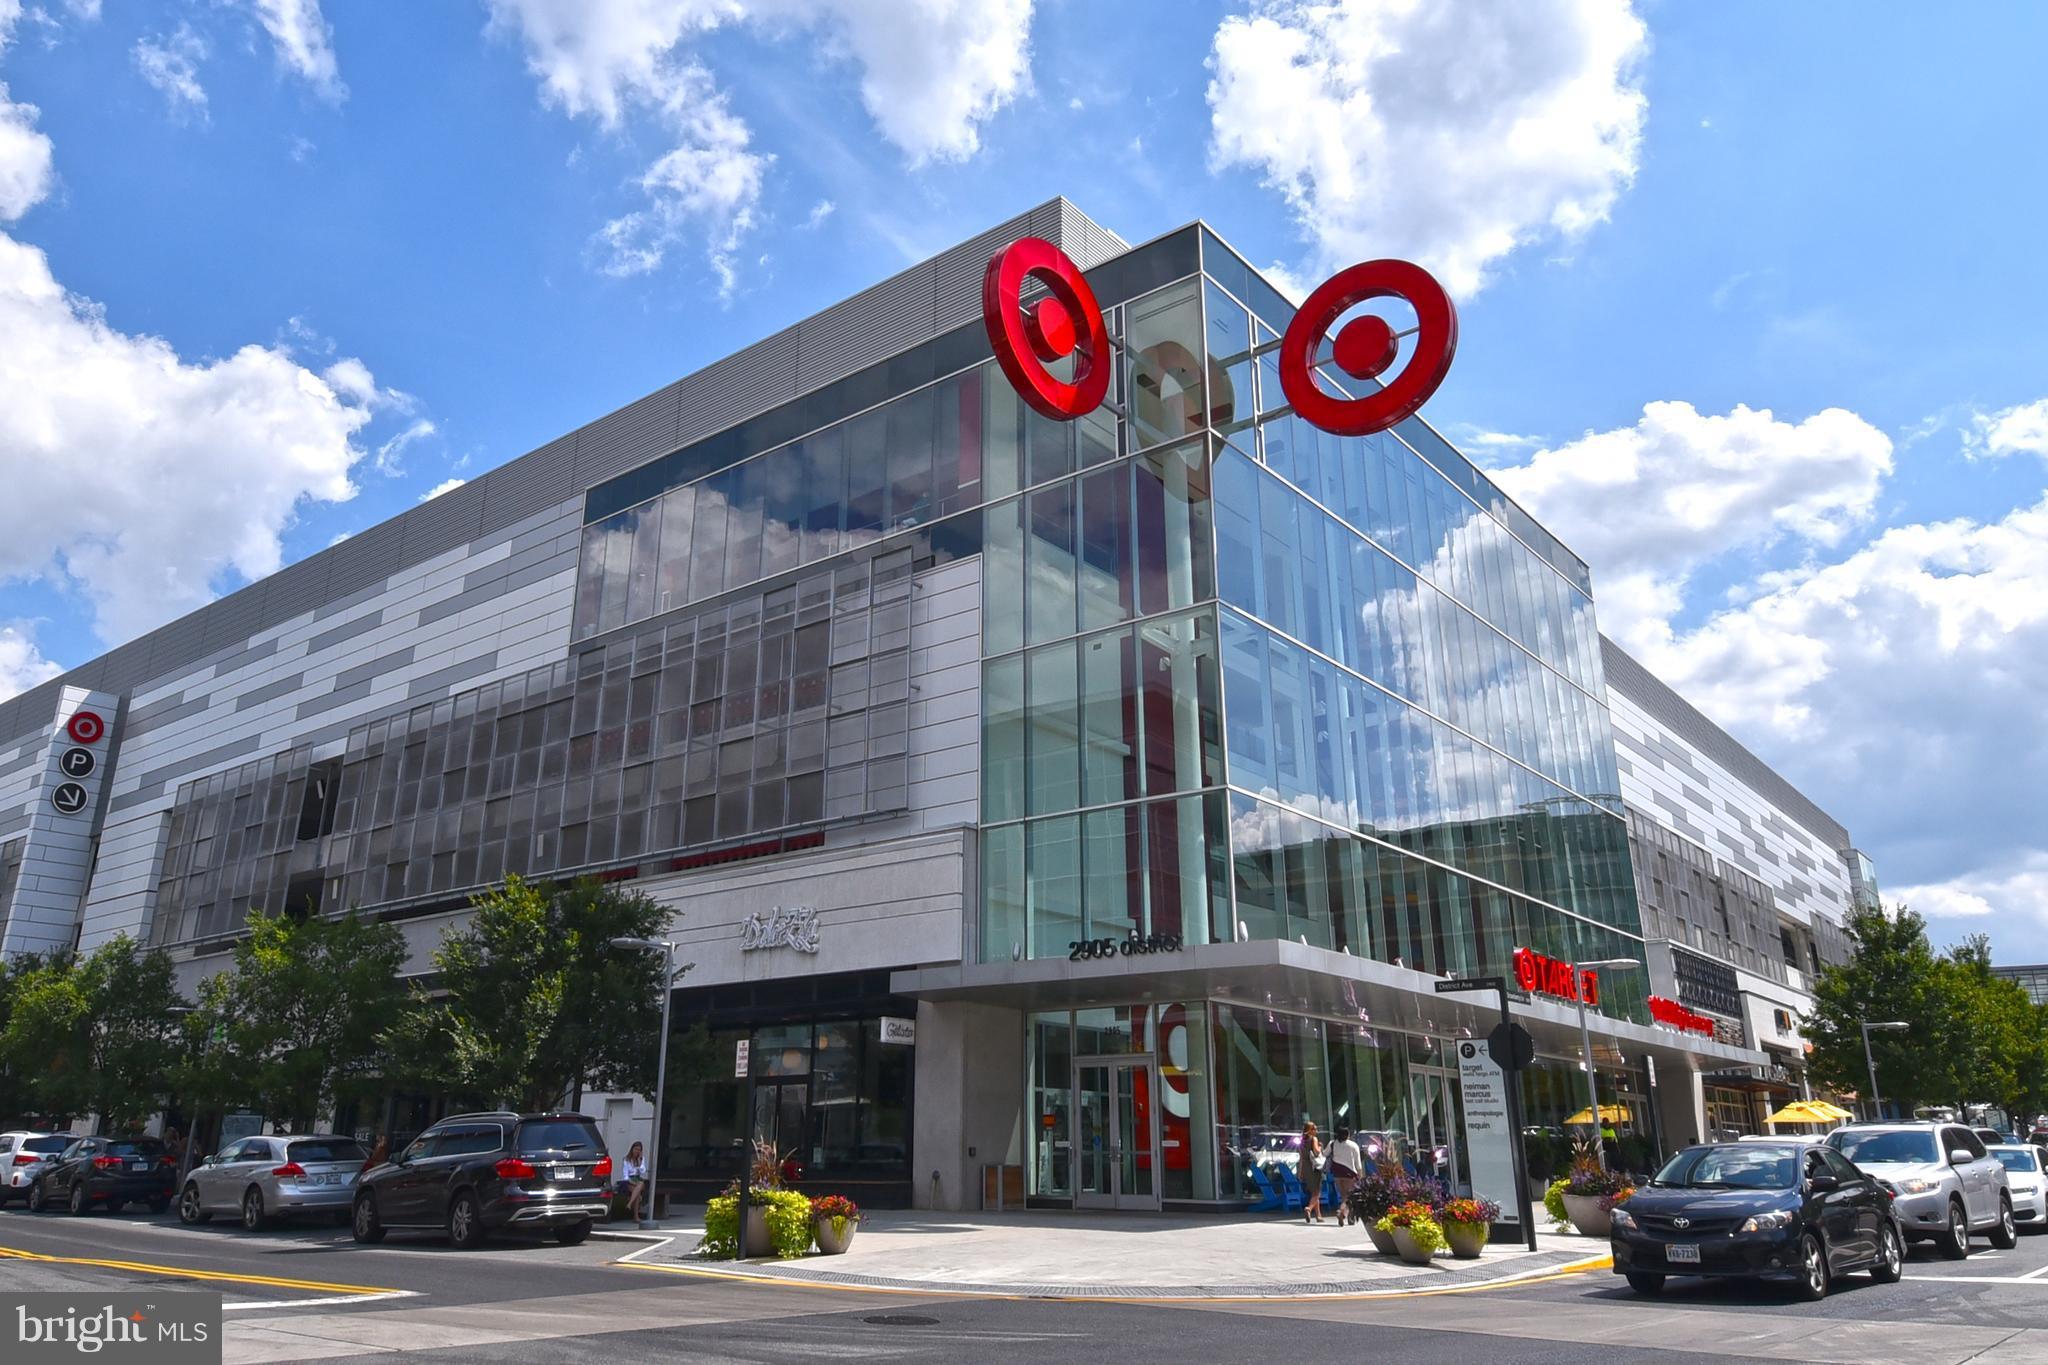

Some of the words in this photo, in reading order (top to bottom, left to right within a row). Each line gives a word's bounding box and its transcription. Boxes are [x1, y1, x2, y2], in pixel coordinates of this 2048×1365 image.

[70, 753, 87, 769] P
[1069, 938, 1118, 962] 2905
[1120, 930, 1184, 957] district
[1438, 982, 1460, 991] District
[1461, 980, 1473, 989] Ave
[1464, 1045, 1472, 1056] P
[1462, 1064, 1483, 1072] target
[1464, 1082, 1490, 1090] neiman
[1468, 1121, 1490, 1130] requin
